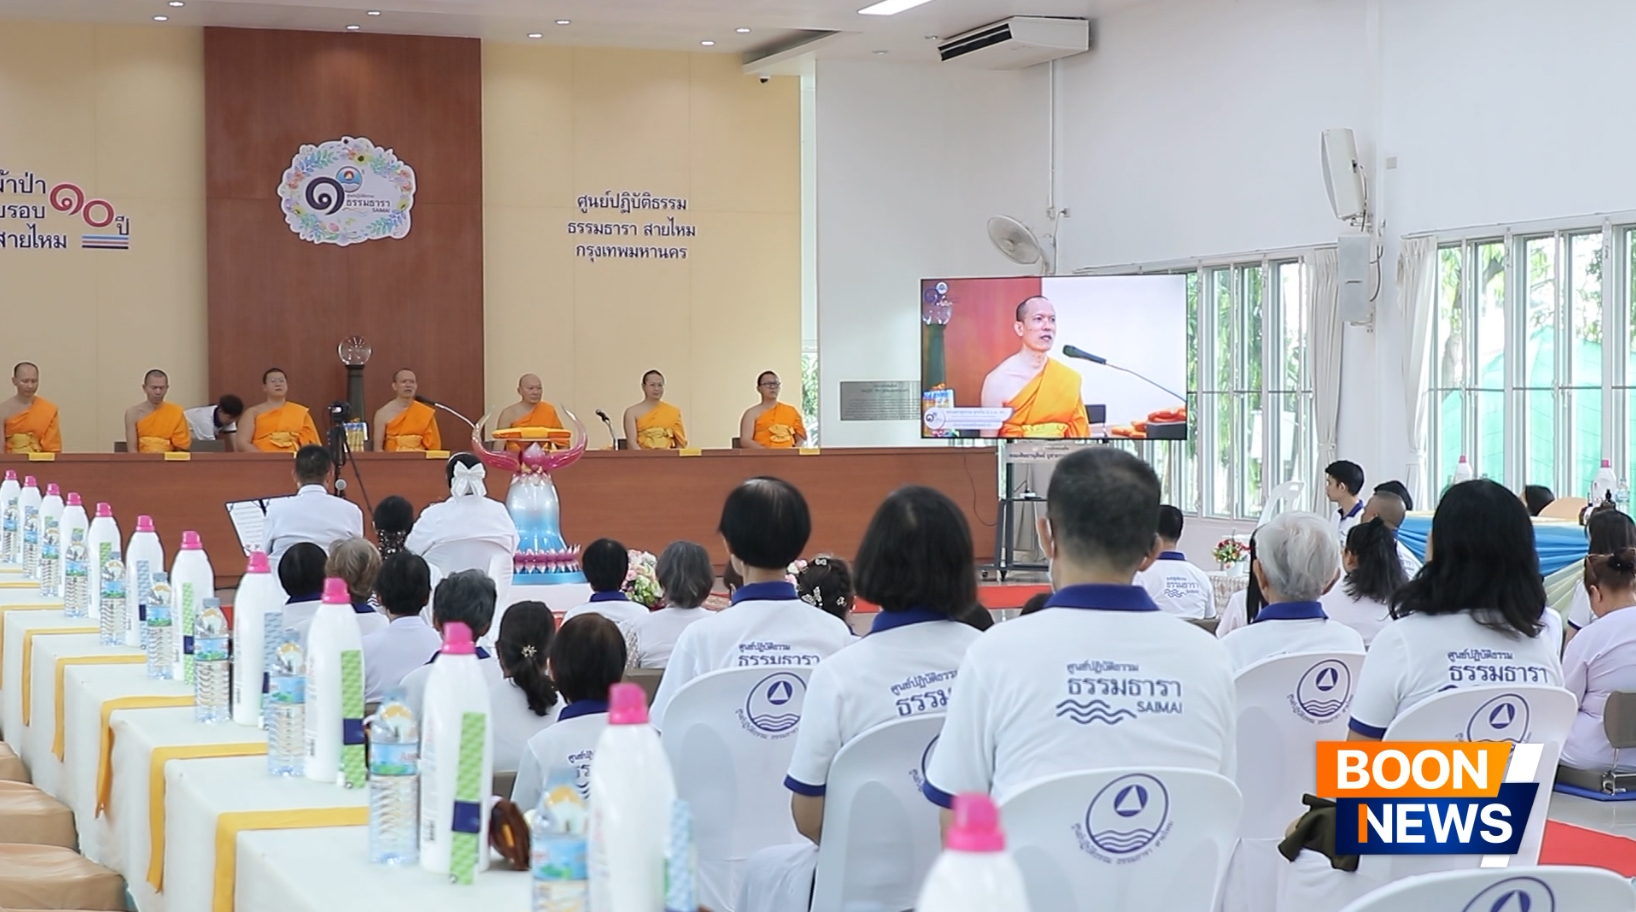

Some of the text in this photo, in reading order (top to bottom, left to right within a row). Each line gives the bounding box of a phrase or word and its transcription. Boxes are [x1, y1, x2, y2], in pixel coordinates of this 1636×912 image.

[577, 190, 687, 213] ศูนย์ปฏิบัติธรรม
[567, 217, 696, 237] ธรรมธารา สายไหม
[576, 245, 687, 262] กรุงเทพมหานคร
[739, 641, 791, 653] ศูนย์ปฏิบัติธรรม
[1448, 648, 1513, 662] ศูนย์ปฏิบัติธรรม
[1067, 660, 1139, 674] ศูนย์ปฏิบัติธรรม
[1449, 665, 1548, 683] ธรรมธารา
[1068, 678, 1182, 697] ธรรมธารา
[1137, 701, 1182, 714] SAIMAI
